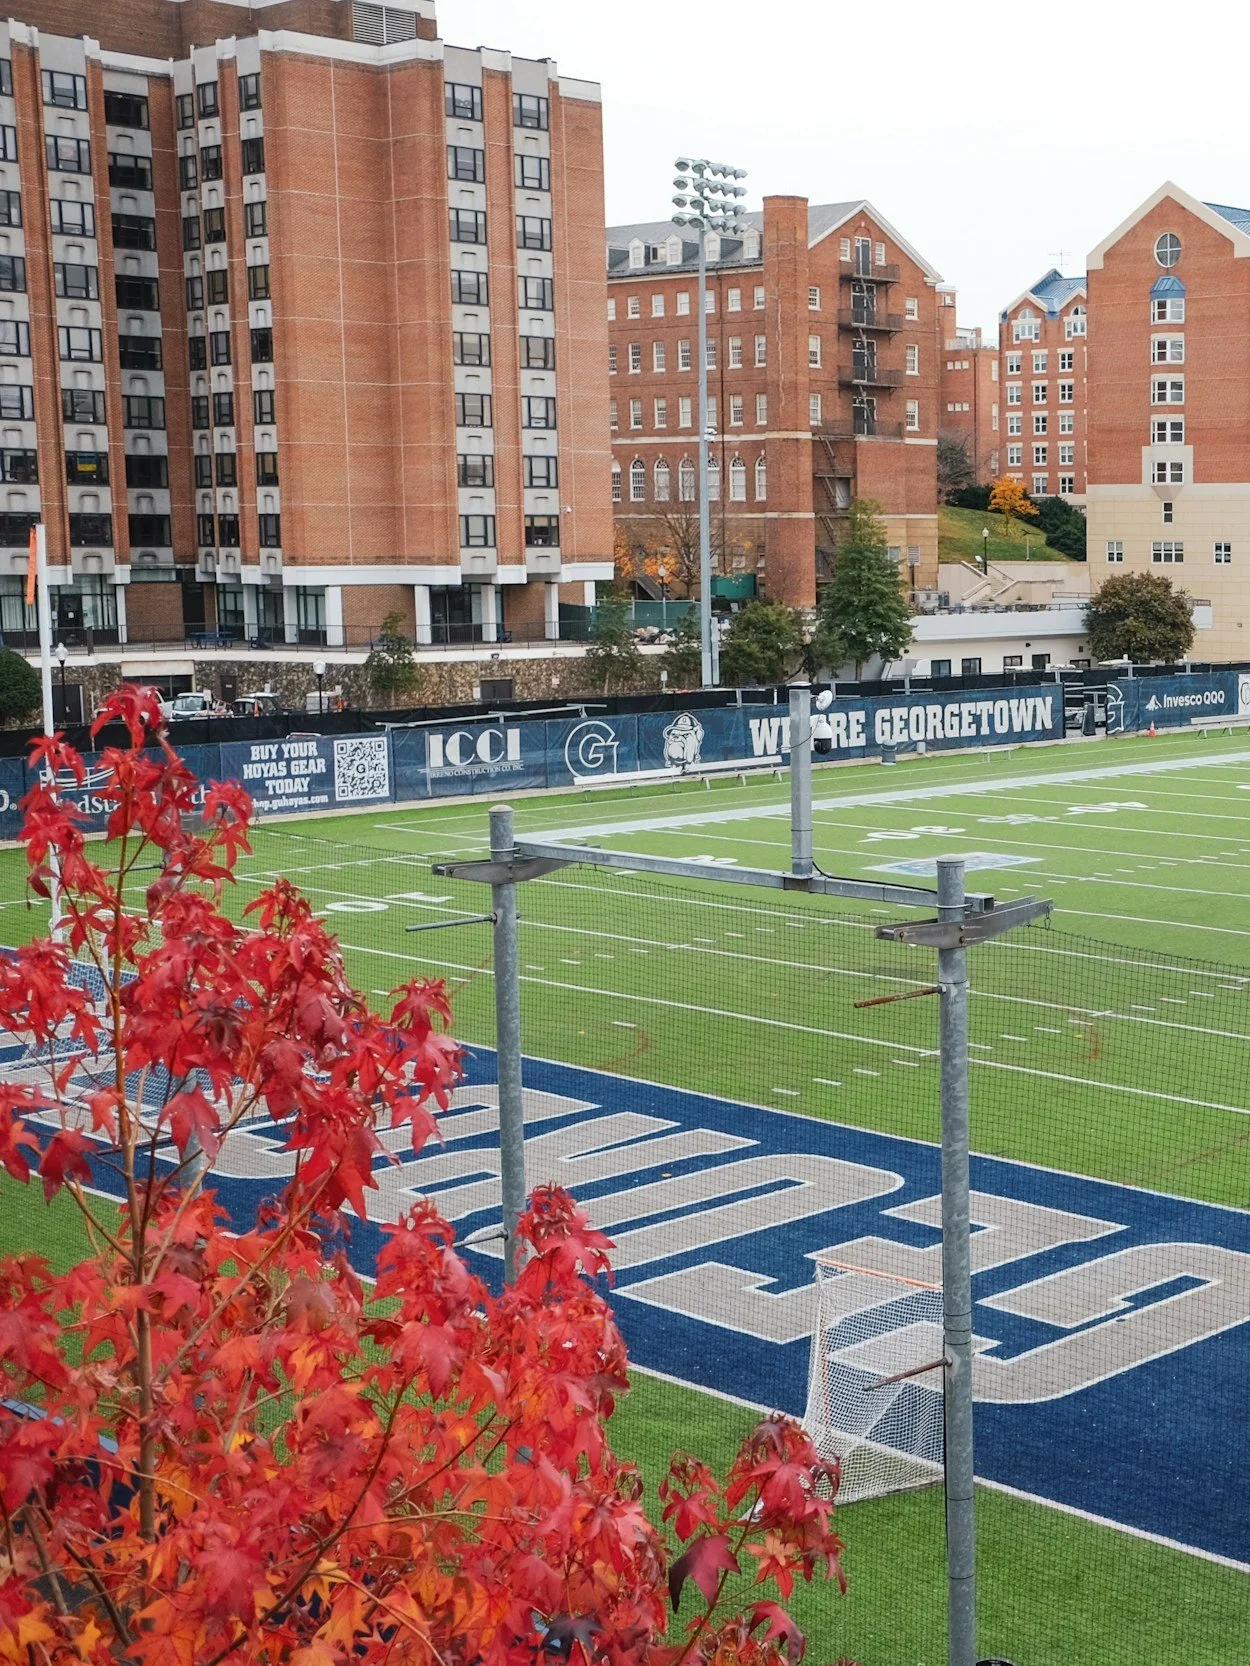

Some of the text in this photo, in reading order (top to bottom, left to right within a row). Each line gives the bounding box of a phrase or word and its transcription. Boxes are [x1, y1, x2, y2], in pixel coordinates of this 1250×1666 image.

[1163, 690, 1225, 709] Invesco QQQ
[874, 696, 1053, 744] GEORGETOWN
[250, 741, 318, 761] BUY YOUR
[429, 728, 520, 768] ICCI
[243, 758, 326, 779] HOYAS GEAR
[454, 766, 500, 777] CONSTRUCTION
[265, 777, 310, 795] TODAY
[252, 794, 329, 811] hop.guhoyas.com
